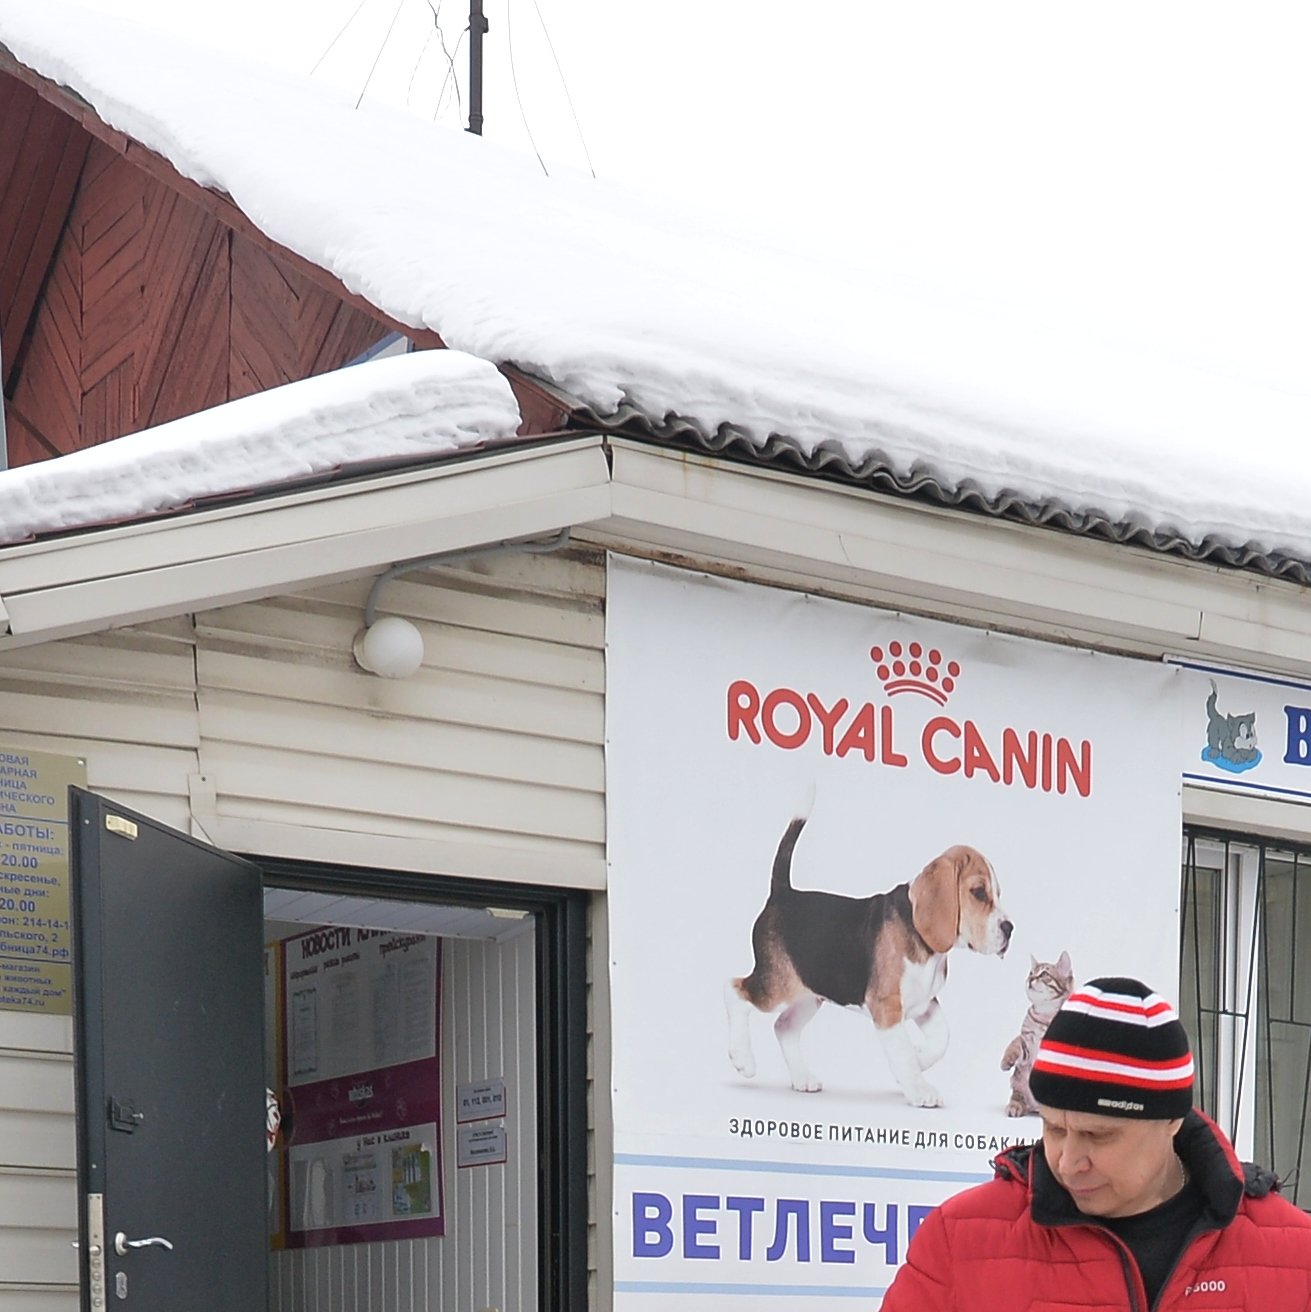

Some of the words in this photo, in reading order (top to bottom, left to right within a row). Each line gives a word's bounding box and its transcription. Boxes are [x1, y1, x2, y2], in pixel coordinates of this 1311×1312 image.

[726, 679, 908, 767] ROYAL
[922, 716, 1092, 798] CANIN
[0, 853, 38, 869] 20.00
[24, 887, 50, 898] дни:
[23, 917, 69, 930] 214-14-1
[52, 932, 58, 942] 2
[4, 975, 51, 985] животных
[729, 1118, 823, 1140] ЗДОРОВОЕ
[829, 1125, 911, 1146] ПИТАНИЕ
[914, 1131, 949, 1150] ДЛЯ
[954, 1134, 1010, 1151] СОБАК
